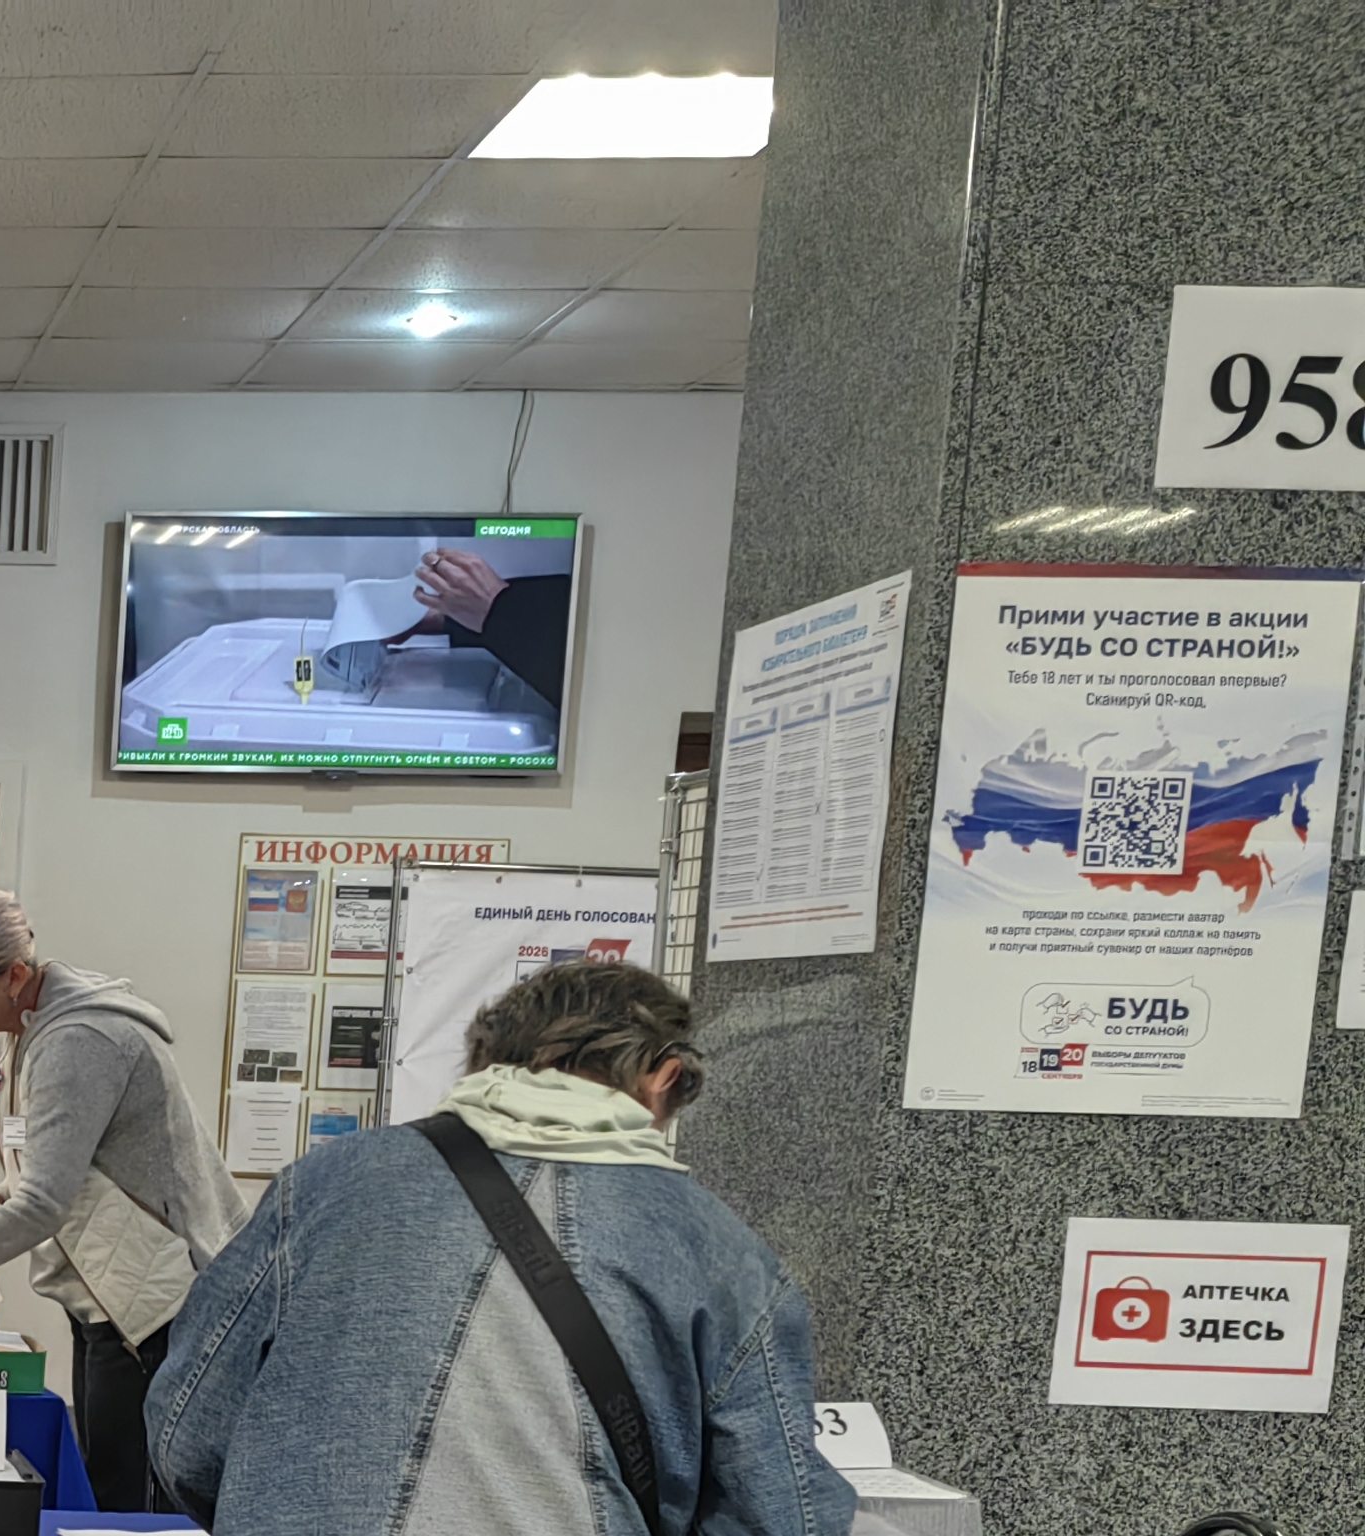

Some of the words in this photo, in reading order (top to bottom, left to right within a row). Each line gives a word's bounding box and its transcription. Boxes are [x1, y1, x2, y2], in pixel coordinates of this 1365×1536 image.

[218, 525, 260, 534] ОБЛАСТЬ
[480, 525, 531, 536] СЕГОДНЯ
[998, 605, 1085, 630] Прими
[1093, 610, 1199, 631] участие
[1207, 612, 1221, 627] в
[1229, 612, 1308, 631] акции
[1005, 636, 1092, 660] «БУДЬ
[1100, 637, 1138, 657] СО
[1146, 634, 1300, 659] СТРАНОЙ!»
[1008, 670, 1038, 684] Тебе
[1042, 671, 1055, 684] 18
[1058, 674, 1081, 685] лет
[1085, 674, 1094, 684] и
[1098, 674, 1115, 685] ты
[1119, 674, 1215, 687] проголосовал
[1220, 674, 1287, 689] впервые?
[1086, 692, 1151, 710] Сканируй
[169, 753, 175, 761] К
[179, 753, 228, 762] ГРОМКИМ
[232, 754, 277, 763] ЗВУКАМ,
[281, 754, 294, 763] ИХ
[298, 755, 338, 763] МОЖНО
[342, 755, 401, 764] ОТПУГНУТЬ
[444, 755, 450, 764] И
[454, 756, 497, 765] СВЕТОМ
[255, 841, 494, 864] ИНФОРМАЦИЯ
[475, 906, 533, 921] ЕДИНЫЙ
[536, 909, 571, 922] ДЕНЬ
[1022, 910, 1068, 921] проходи
[1071, 911, 1084, 920] по
[985, 926, 998, 935] на
[1001, 927, 1031, 937] карте
[1080, 927, 1125, 938] сохрани
[1128, 927, 1160, 939] яркий
[1207, 930, 1220, 939] на
[1223, 930, 1261, 940] память
[518, 946, 548, 957] 2026
[989, 942, 996, 951] и
[999, 942, 1037, 954] получи
[1040, 941, 1094, 953] приятный
[1145, 945, 1156, 954] от
[1107, 997, 1190, 1024] БУДЬ
[1104, 1026, 1121, 1036] СО
[1126, 1025, 1189, 1037] СТРАНОЙ!
[1021, 1061, 1038, 1073] 18
[1042, 1054, 1059, 1067] 19
[1062, 1048, 1083, 1062] 20
[1182, 1284, 1290, 1303] АПТЕЧКА
[1178, 1318, 1285, 1343] ЗДЕСЬ
